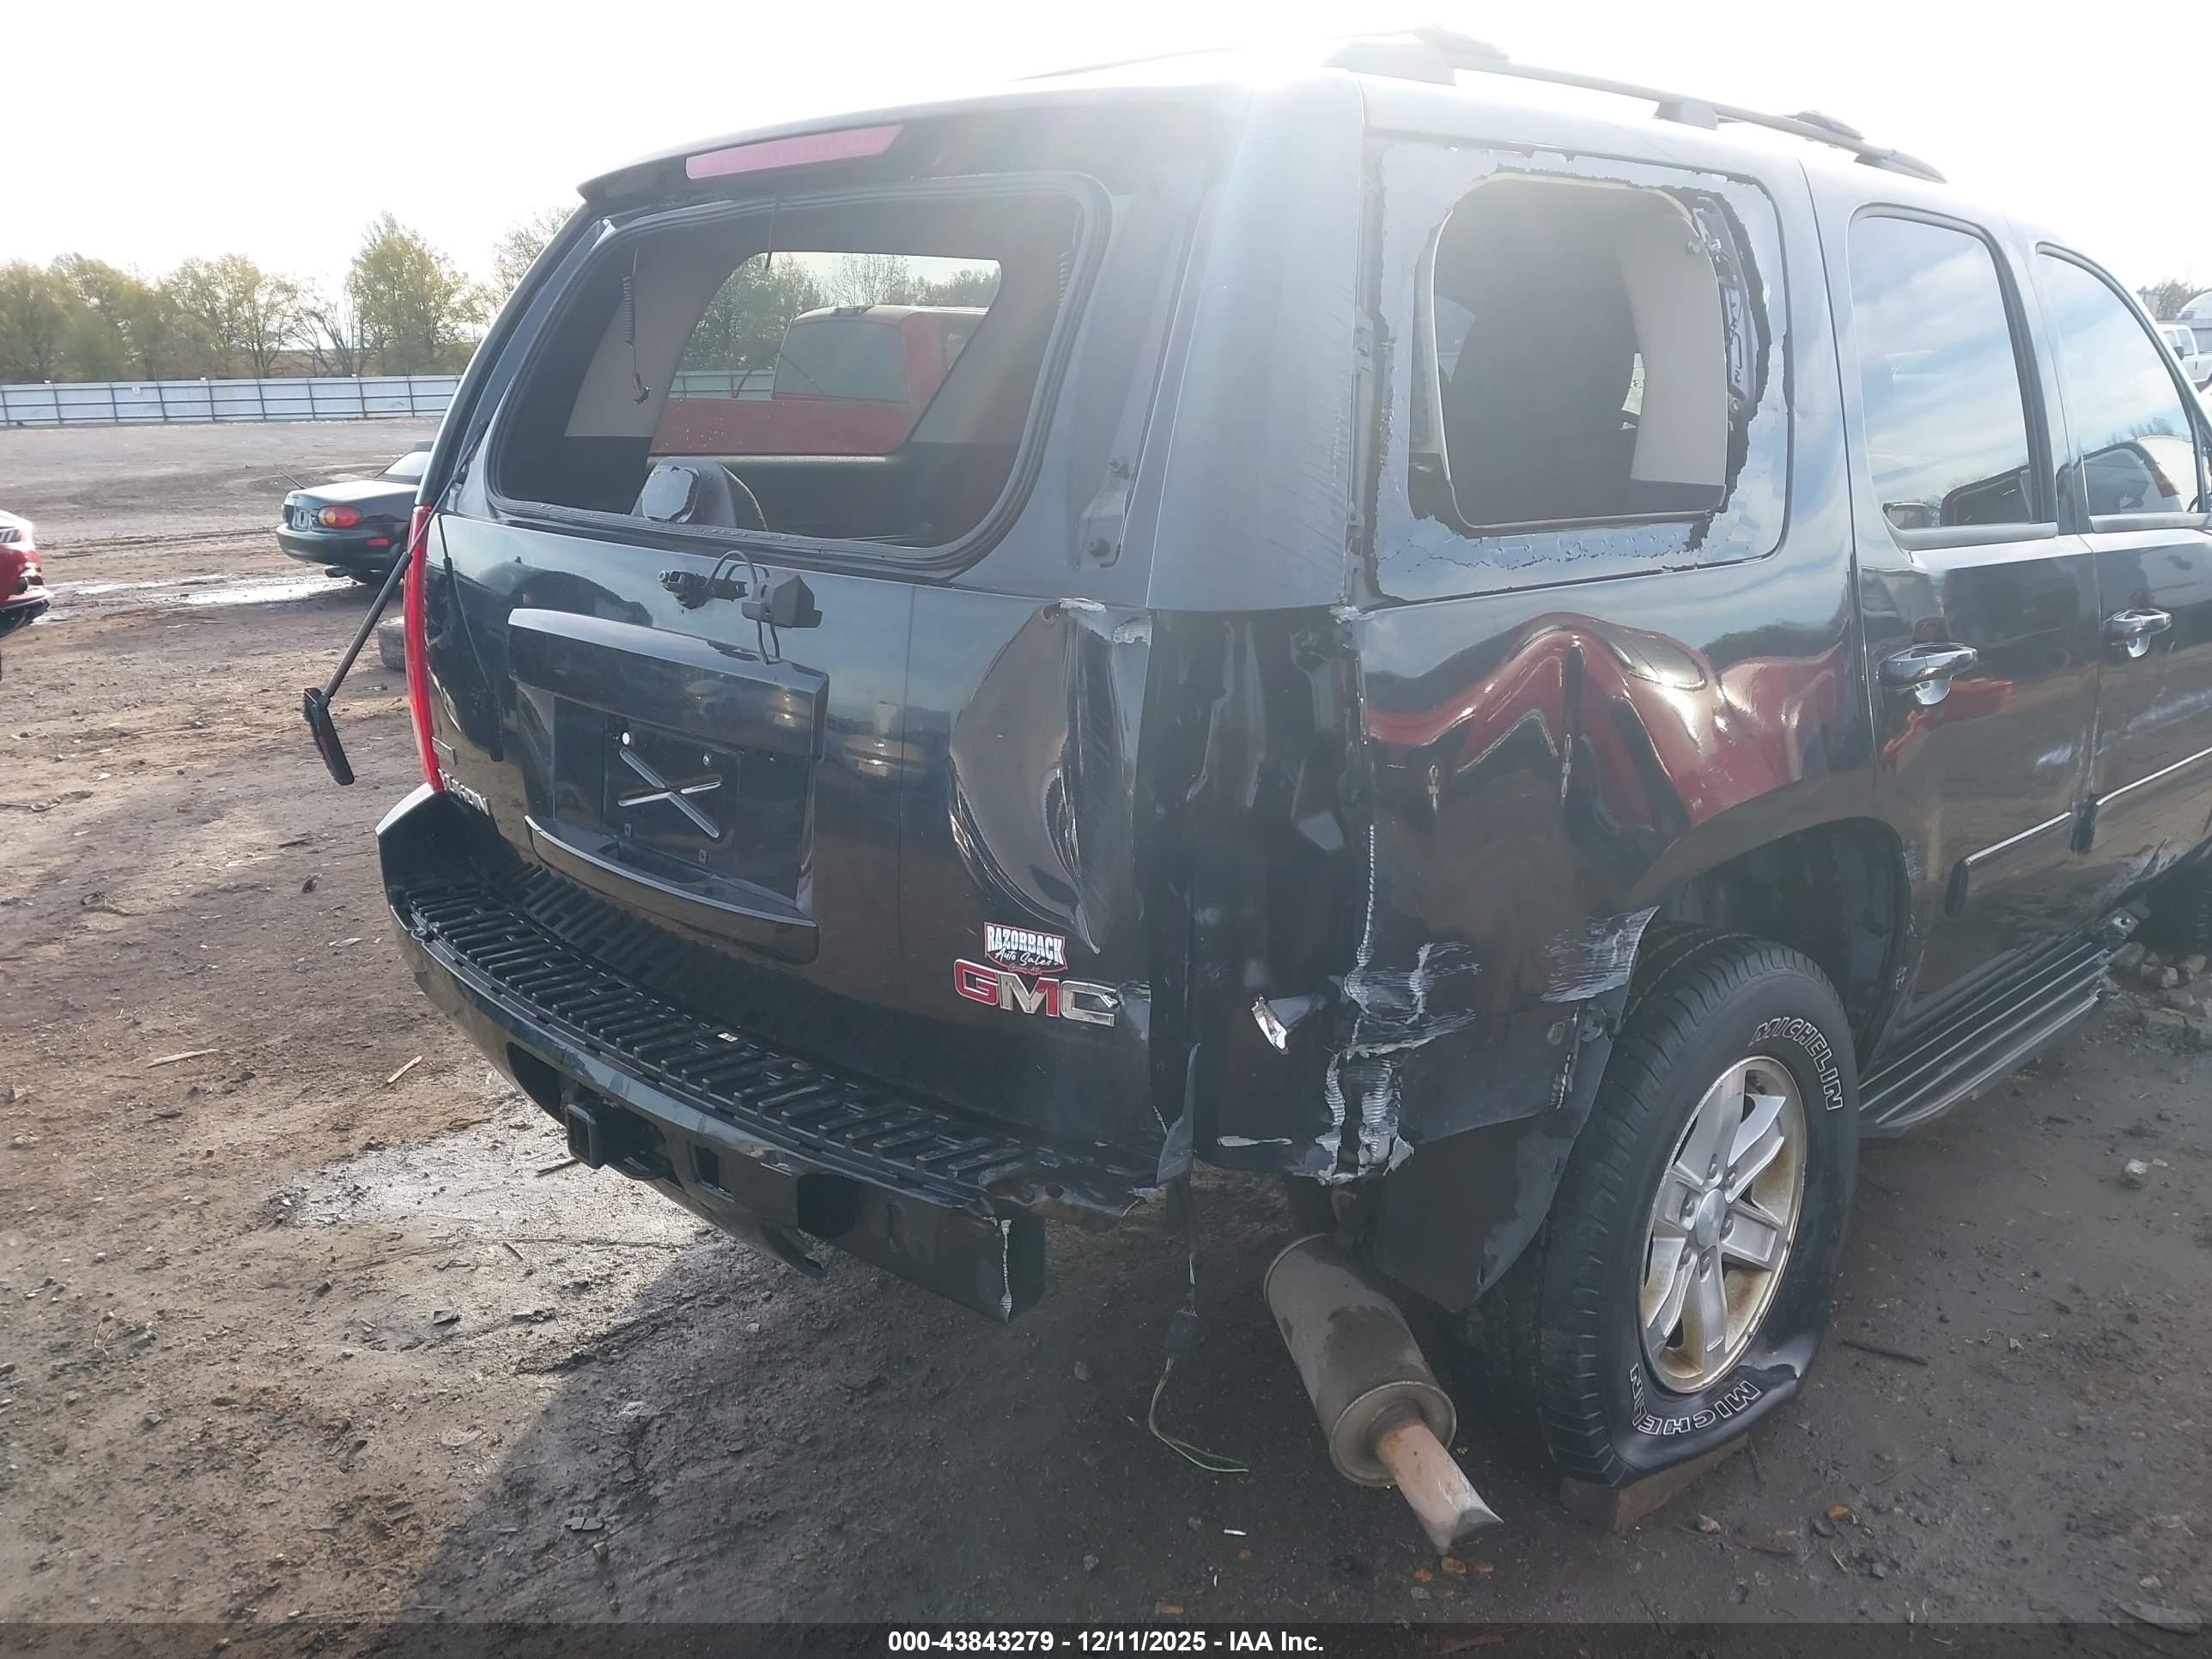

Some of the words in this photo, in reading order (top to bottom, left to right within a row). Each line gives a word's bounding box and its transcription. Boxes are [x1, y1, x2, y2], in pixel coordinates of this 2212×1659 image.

[987, 925, 1064, 966] RAZORBACK
[994, 946, 1017, 963] Auto
[1020, 951, 1052, 967] Sales
[954, 958, 1118, 1027] GMC
[1747, 1017, 1844, 1110] MICHELIN
[1630, 1363, 1762, 1436] MICHELIN
